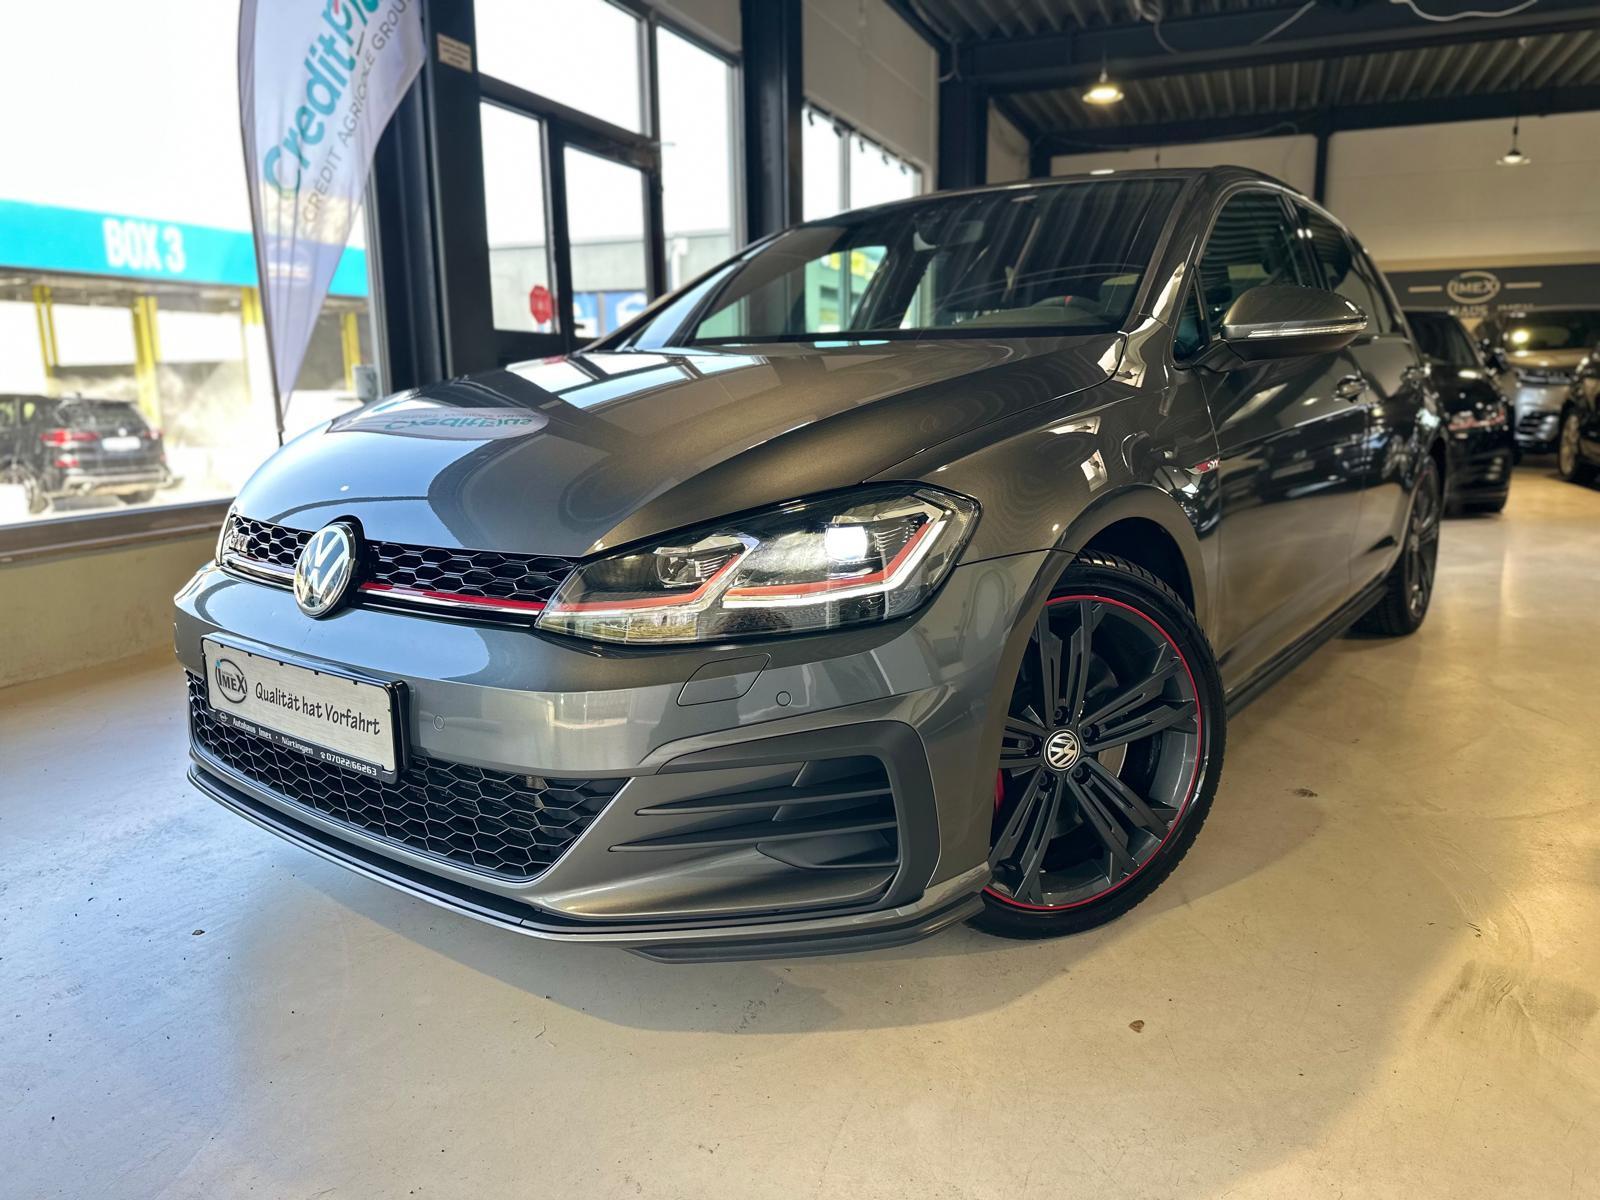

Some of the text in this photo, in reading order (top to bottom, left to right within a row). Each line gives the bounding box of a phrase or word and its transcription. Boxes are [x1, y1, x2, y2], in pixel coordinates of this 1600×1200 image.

[371, 0, 409, 52] GROU
[103, 218, 186, 272] BOX 3
[255, 681, 380, 735] Qualität hat Vorfahrt
